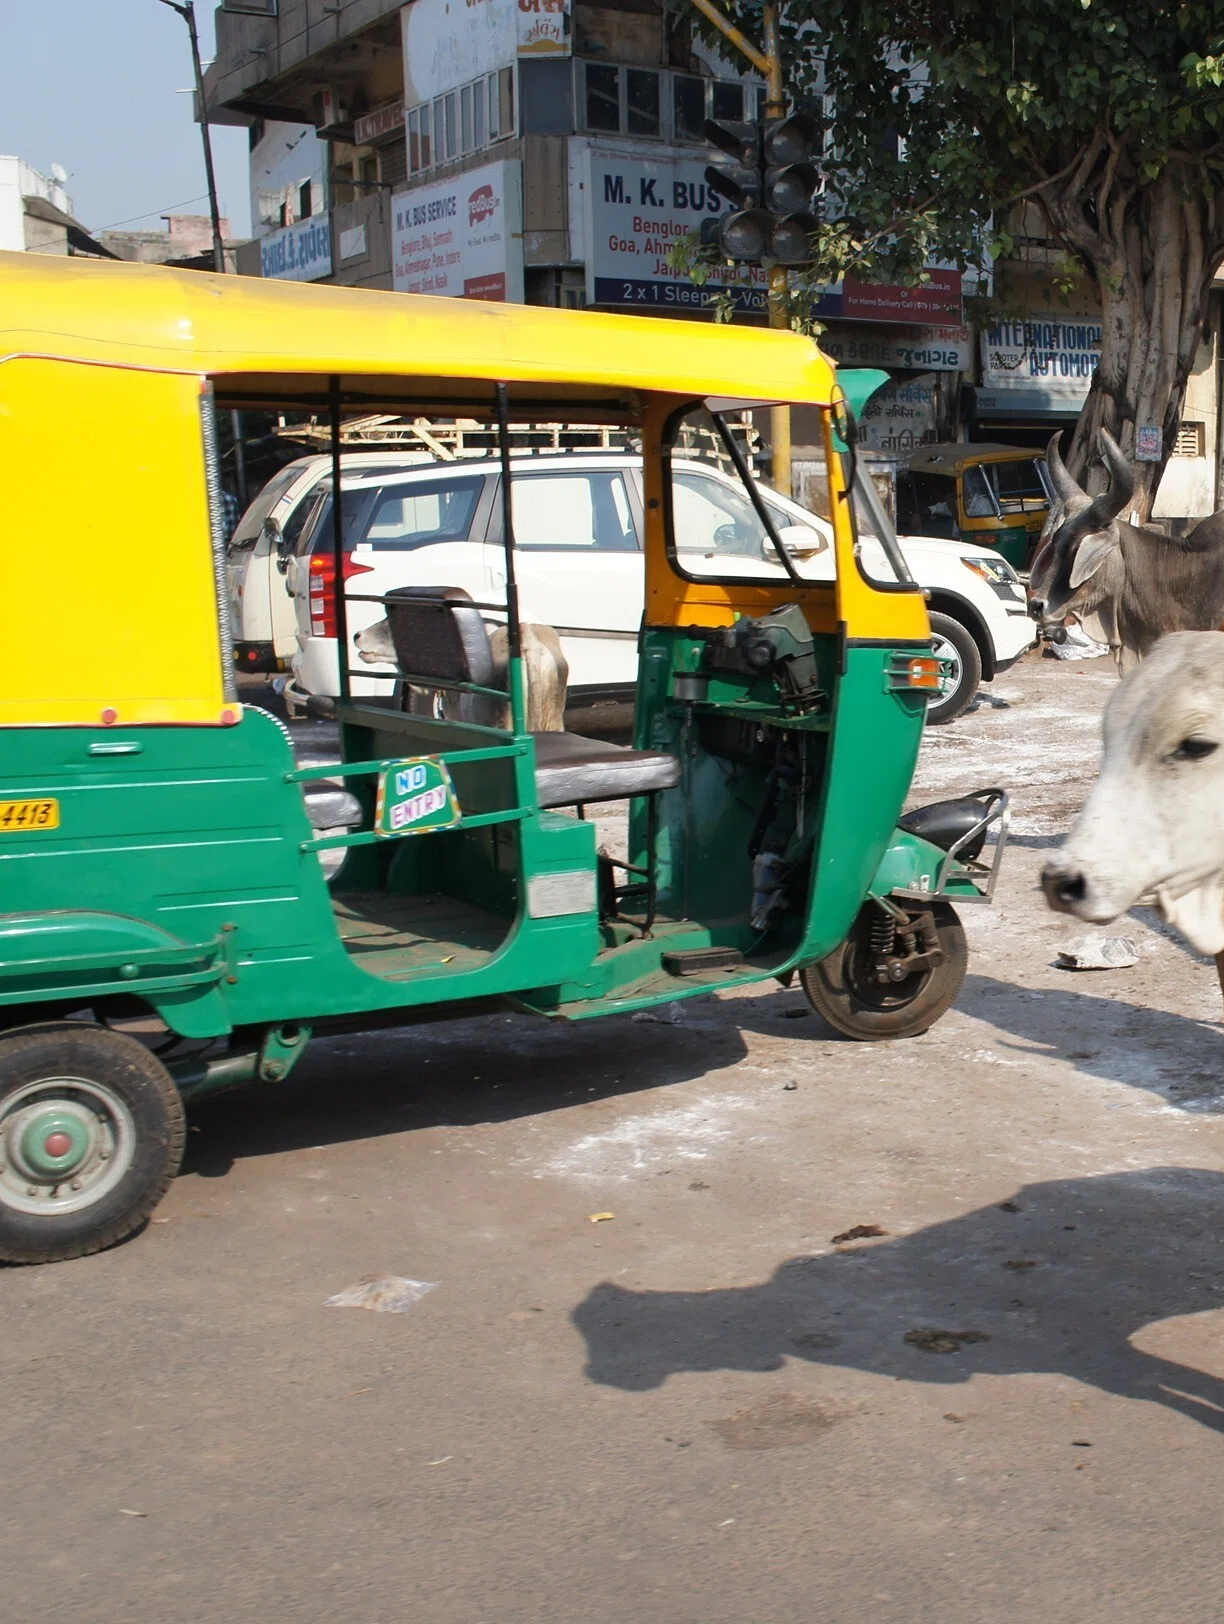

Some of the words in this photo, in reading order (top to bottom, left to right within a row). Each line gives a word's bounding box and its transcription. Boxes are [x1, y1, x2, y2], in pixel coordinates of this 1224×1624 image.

[603, 174, 631, 204] M.
[640, 177, 664, 208] K.
[672, 181, 722, 213] BUS
[396, 213, 405, 232] M.
[405, 209, 412, 229] K.
[413, 204, 426, 226] BUS
[427, 196, 457, 222] SERVICE
[632, 216, 689, 239] Benglor
[608, 235, 640, 255] Goa,
[623, 283, 633, 299] 2
[637, 287, 646, 299] x
[651, 285, 659, 300] 1
[848, 297, 859, 305] For
[860, 298, 877, 306] Home
[878, 299, 901, 309] Delivery
[396, 765, 427, 796] NO
[2, 803, 53, 826] 4413
[390, 784, 447, 830] ENTRY
